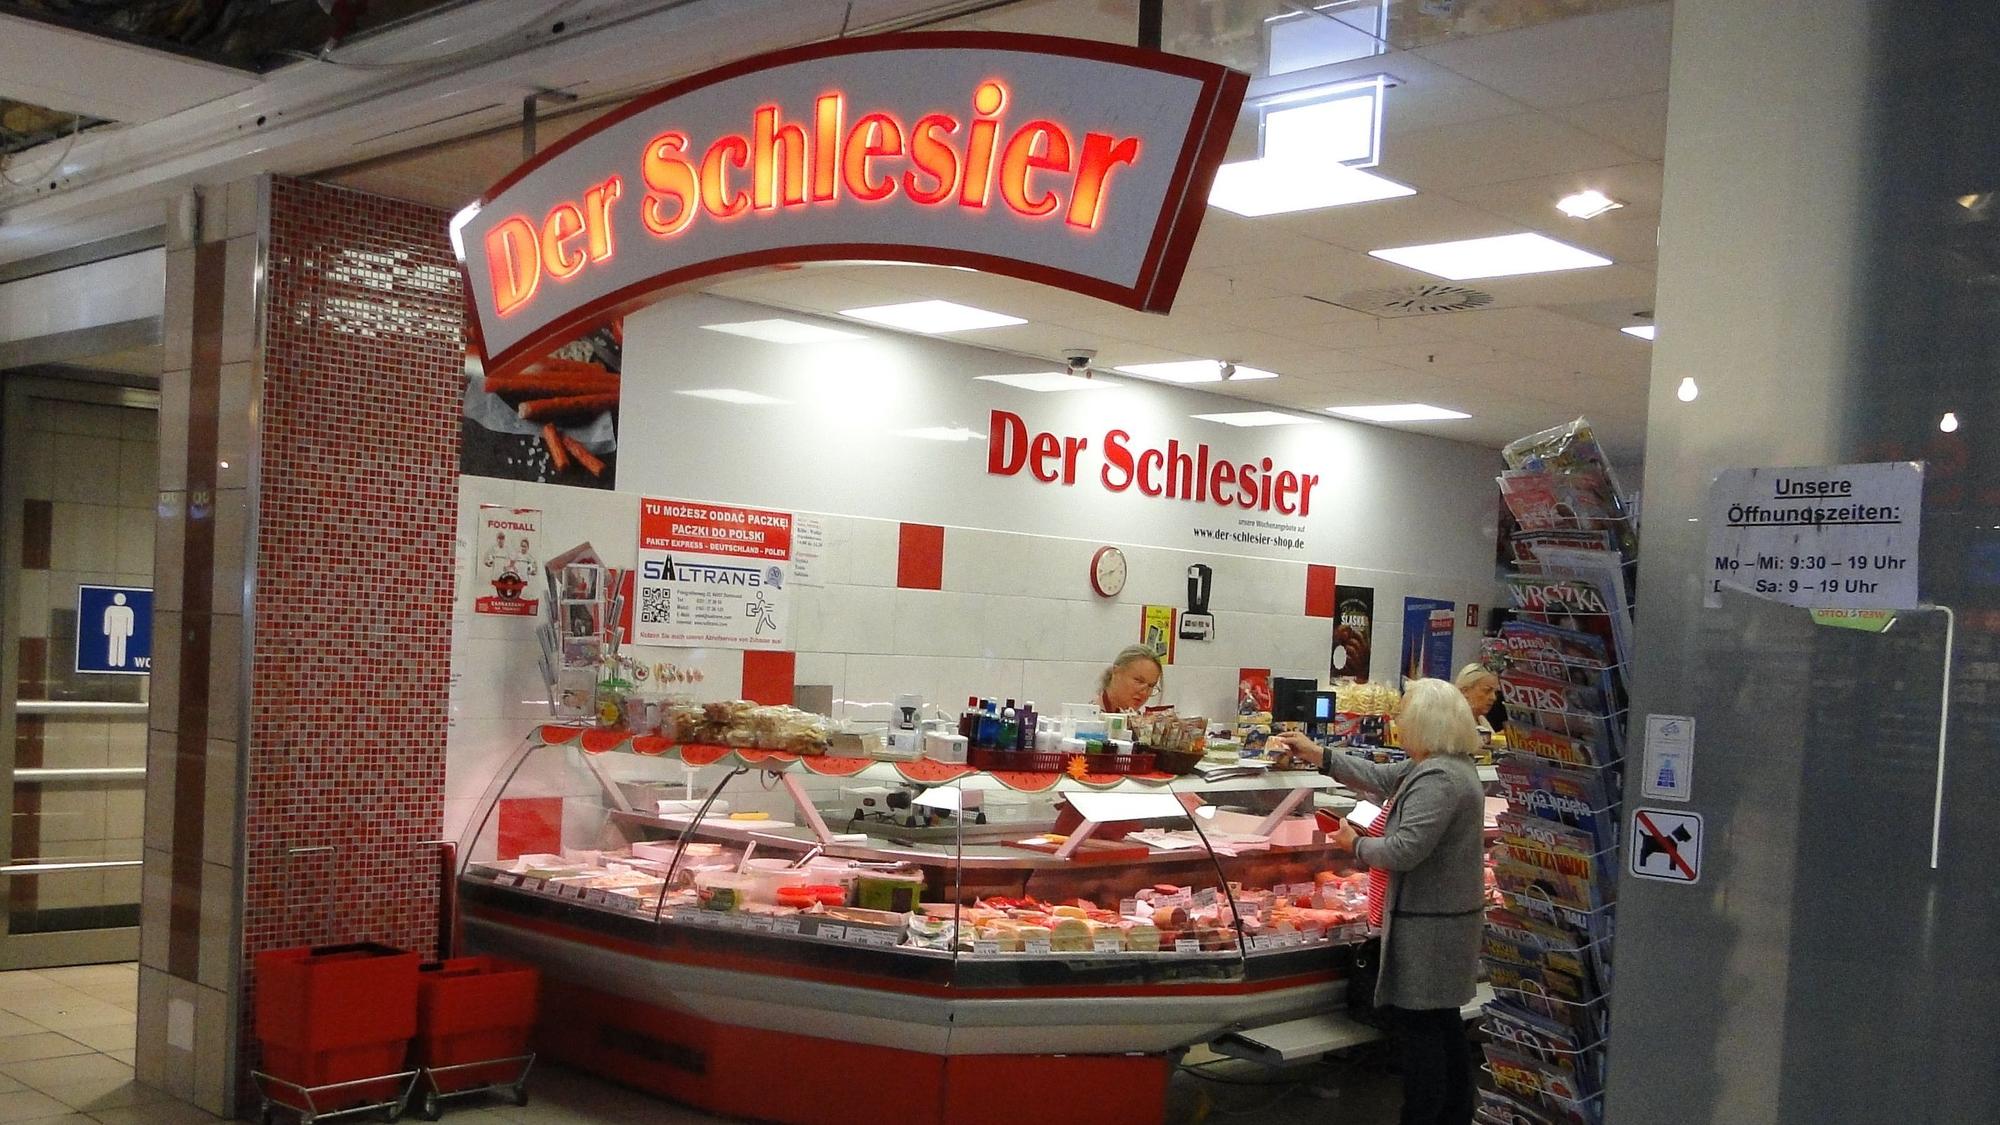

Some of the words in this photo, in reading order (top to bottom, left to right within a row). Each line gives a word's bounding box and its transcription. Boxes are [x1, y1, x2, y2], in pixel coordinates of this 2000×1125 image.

[488, 174, 621, 317] Der
[643, 81, 1138, 236] Schlesier
[988, 408, 1088, 486] Der
[1101, 428, 1319, 517] Schlesier
[1775, 478, 1852, 496] Unsere
[646, 503, 661, 515] TU
[664, 504, 706, 519] MOŻESZ
[709, 510, 745, 523] ODDAĆ
[1728, 502, 1900, 525] Öffnungszeiten:
[488, 520, 536, 532] FOOTBALL
[672, 524, 709, 537] PACZKI
[712, 528, 727, 538] DO
[729, 530, 765, 543] POLSKI
[646, 537, 669, 547] PAKET
[671, 539, 703, 549] EXPRESS
[710, 543, 759, 555] DEUTSCHLAND
[1193, 527, 1305, 549] www.der-schlesier-shop.de
[643, 553, 762, 587] SALTRANS
[1715, 556, 1739, 570] Mo
[1759, 556, 1784, 570] Mi:
[1789, 556, 1826, 570] 9:30
[1848, 556, 1867, 570] 19
[1874, 556, 1906, 570] Uhr
[1755, 579, 1783, 593] Sa:
[1788, 579, 1798, 593] 9
[1819, 579, 1839, 593] 19
[1845, 579, 1878, 593] Uhr
[134, 656, 151, 668] WC
